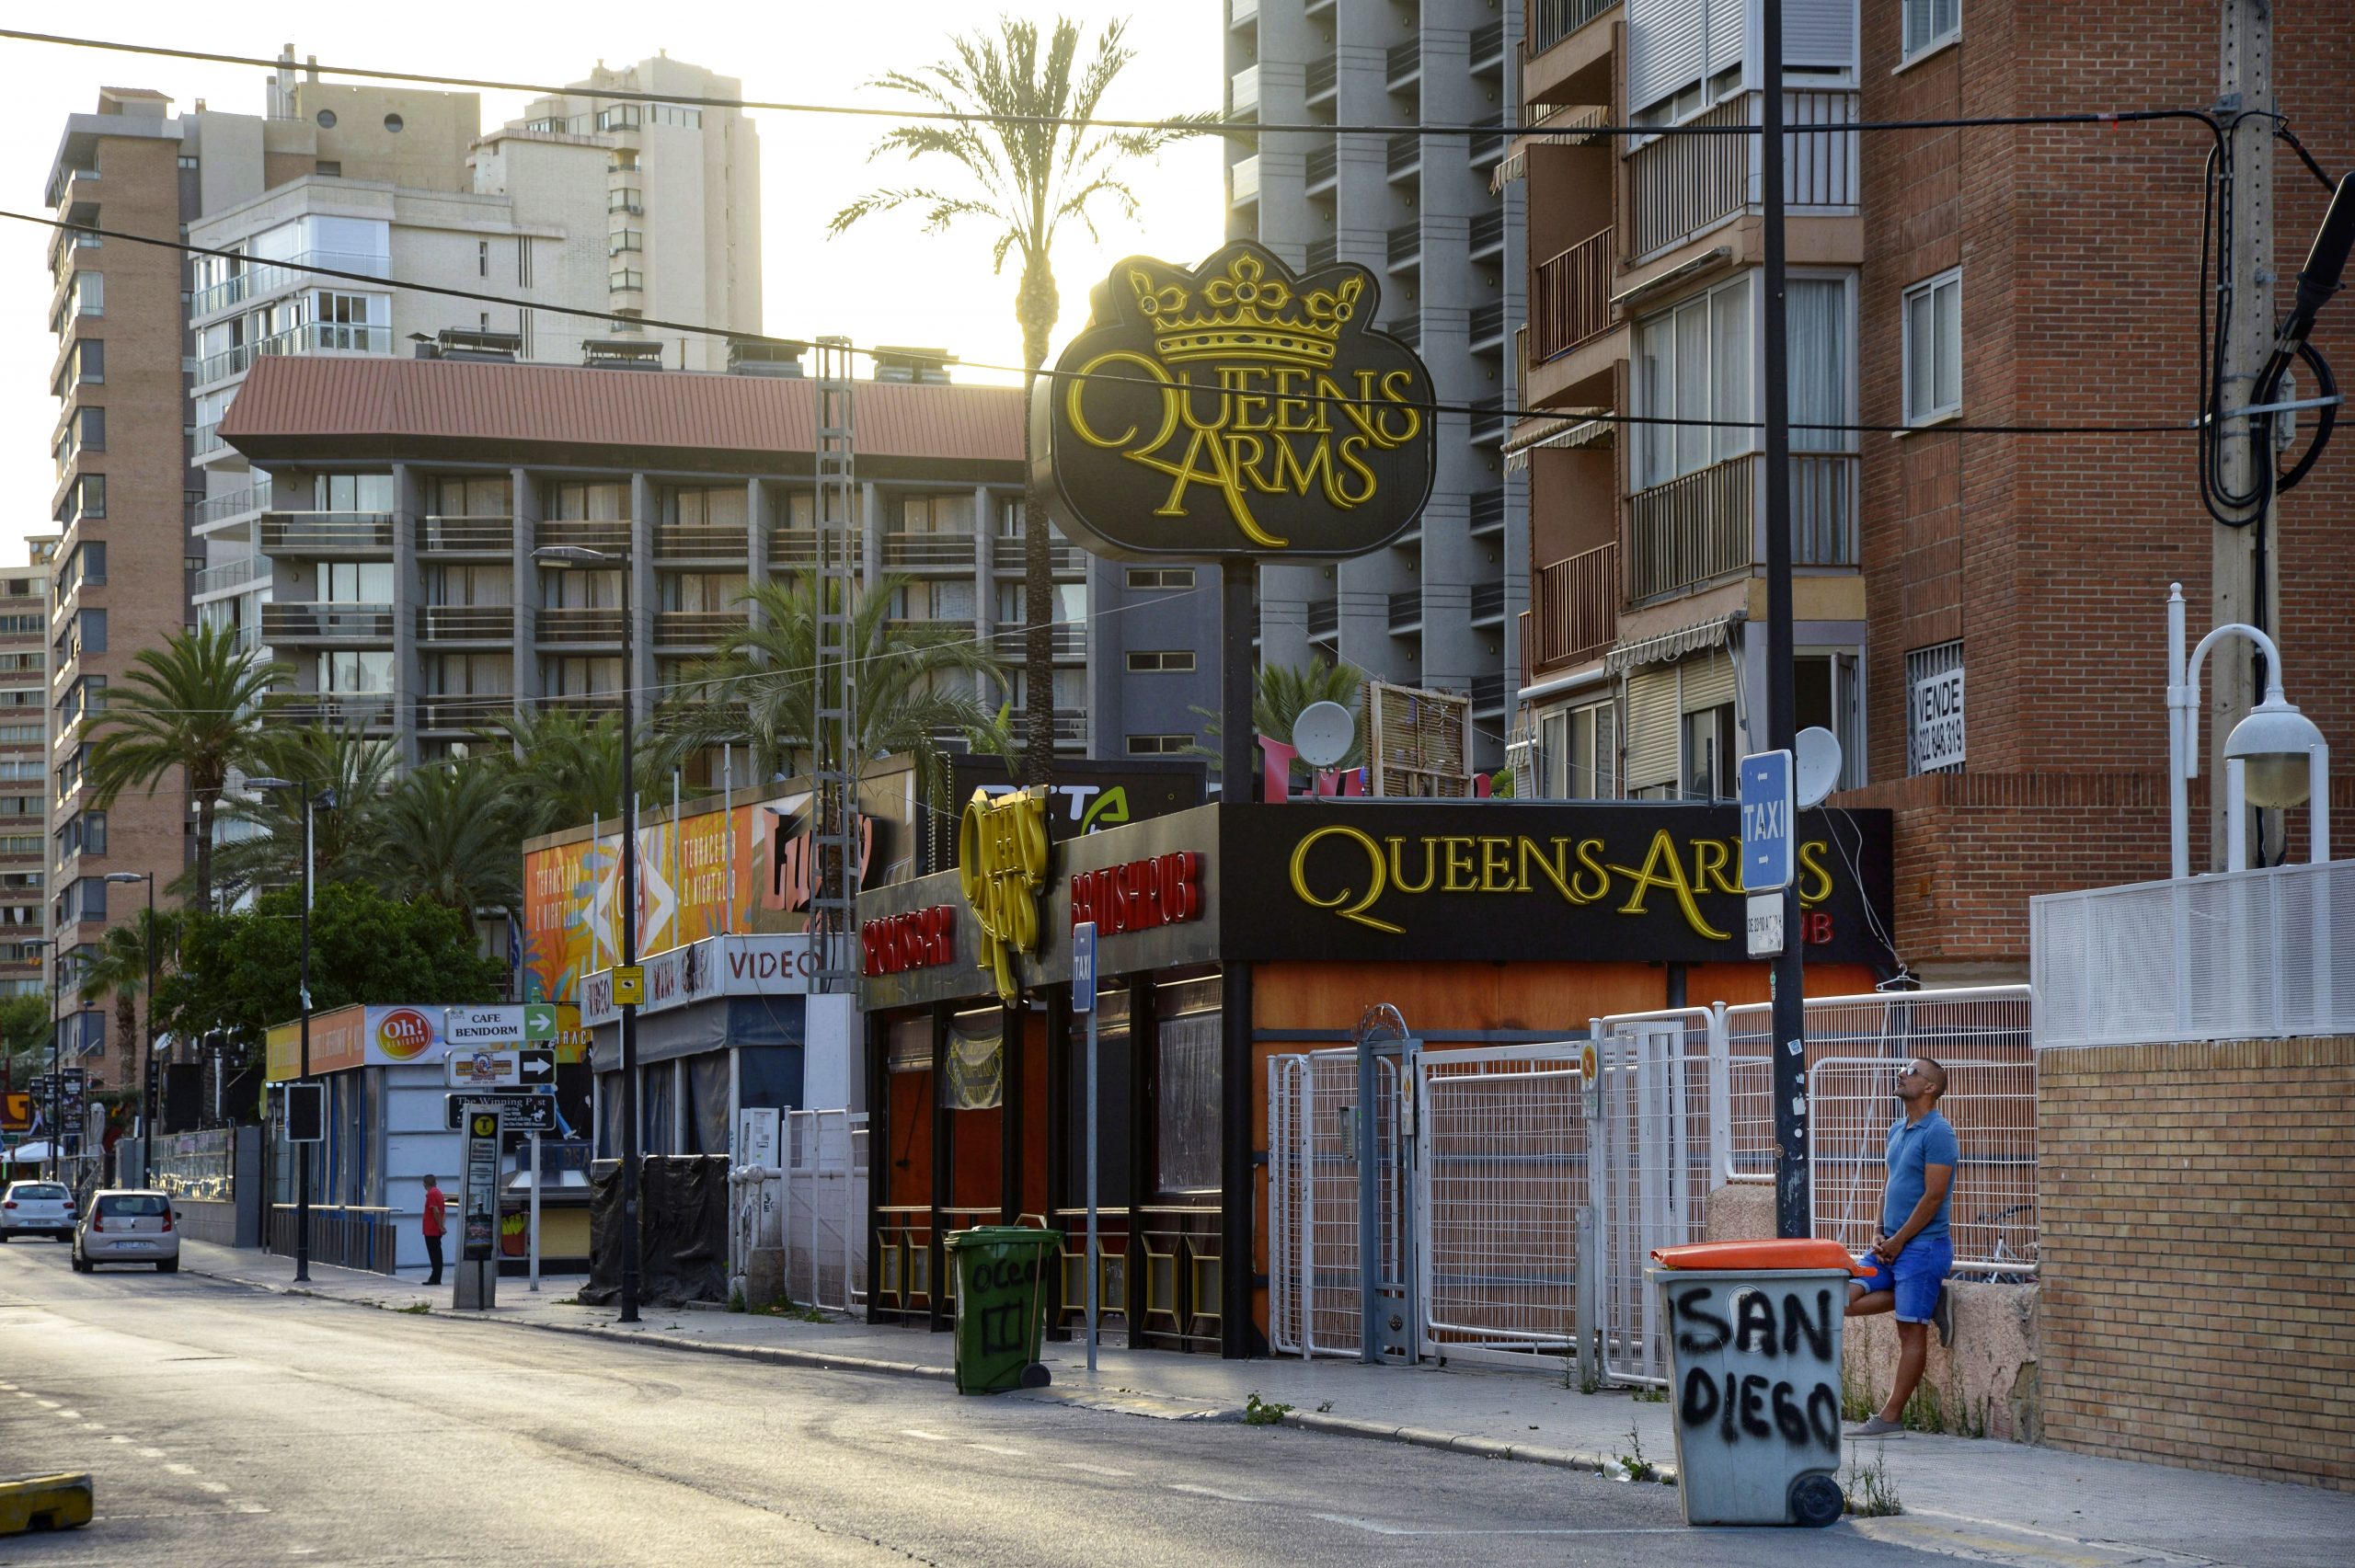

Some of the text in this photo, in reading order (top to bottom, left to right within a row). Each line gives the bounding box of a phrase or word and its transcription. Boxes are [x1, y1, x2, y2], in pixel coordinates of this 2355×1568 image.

[1066, 349, 1421, 487] QUEENS
[1153, 429, 1378, 547] ARMS
[1918, 678, 1960, 724] VENDE
[1744, 799, 1785, 842] TAXI
[684, 830, 737, 869] TERRACE BR
[693, 875, 715, 906] NIGHT
[716, 869, 736, 901] CLB
[1290, 824, 1611, 933] QUEENS
[729, 950, 822, 979] VIDEO
[1074, 955, 1092, 981] TAXI
[384, 1018, 423, 1039] Oh!
[455, 1025, 518, 1037] BENIDORM
[472, 1013, 501, 1024] CAFE
[478, 1096, 523, 1108] Winning
[525, 1097, 546, 1106] Pst
[1677, 1287, 1832, 1364] SAN
[1681, 1366, 1840, 1453] DIEGO
